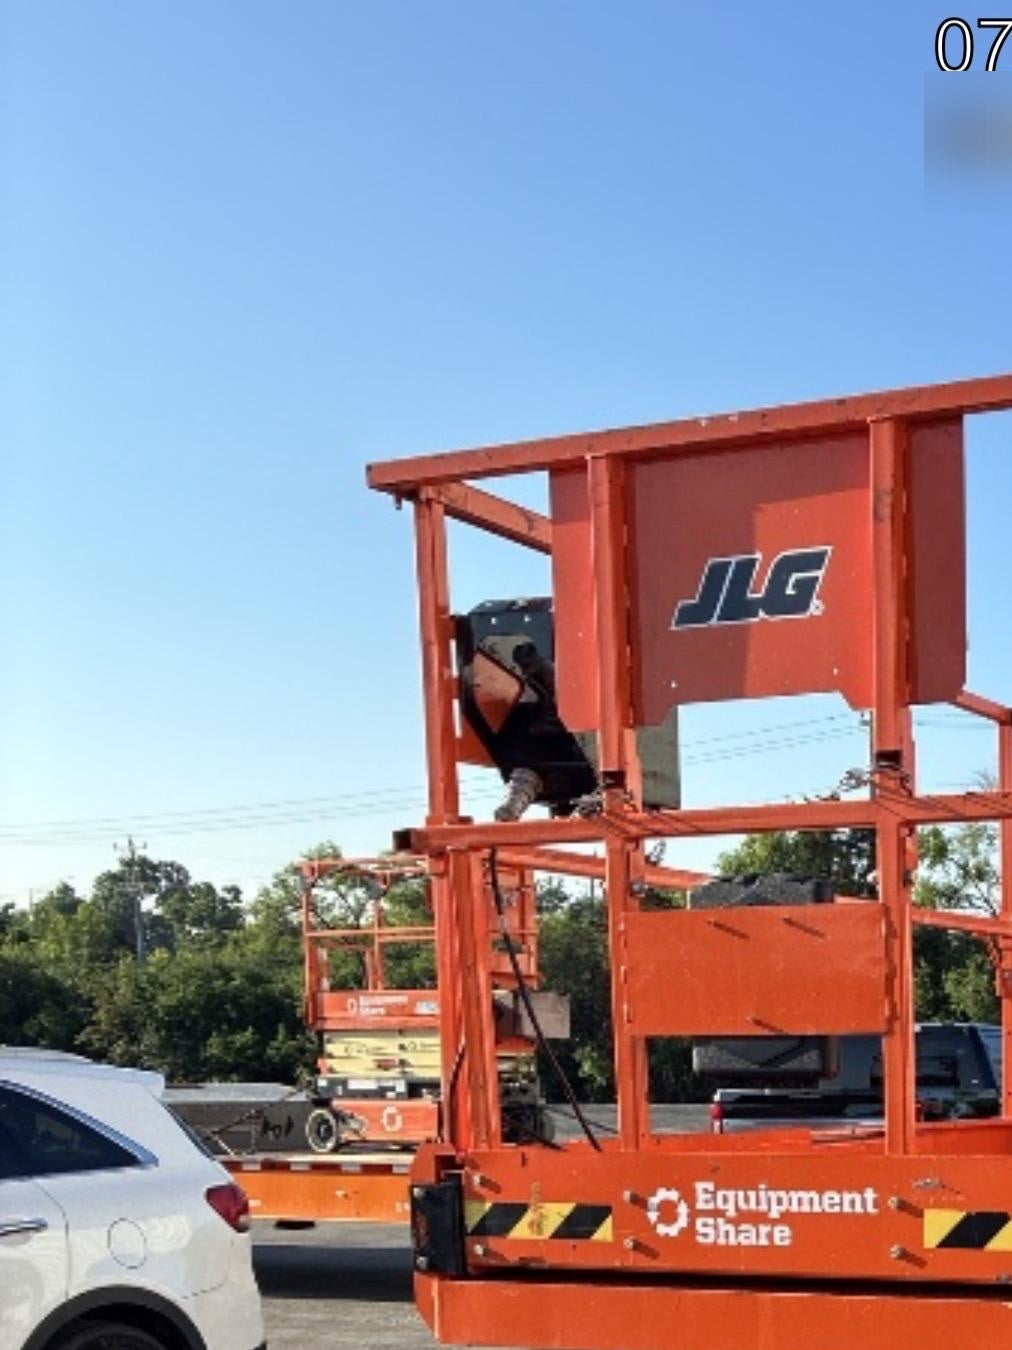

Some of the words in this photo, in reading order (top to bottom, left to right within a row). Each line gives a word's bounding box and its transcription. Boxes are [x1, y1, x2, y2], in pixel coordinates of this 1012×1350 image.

[668, 544, 833, 630] JLG
[694, 1181, 879, 1219] Equipment
[694, 1217, 793, 1247] Share
